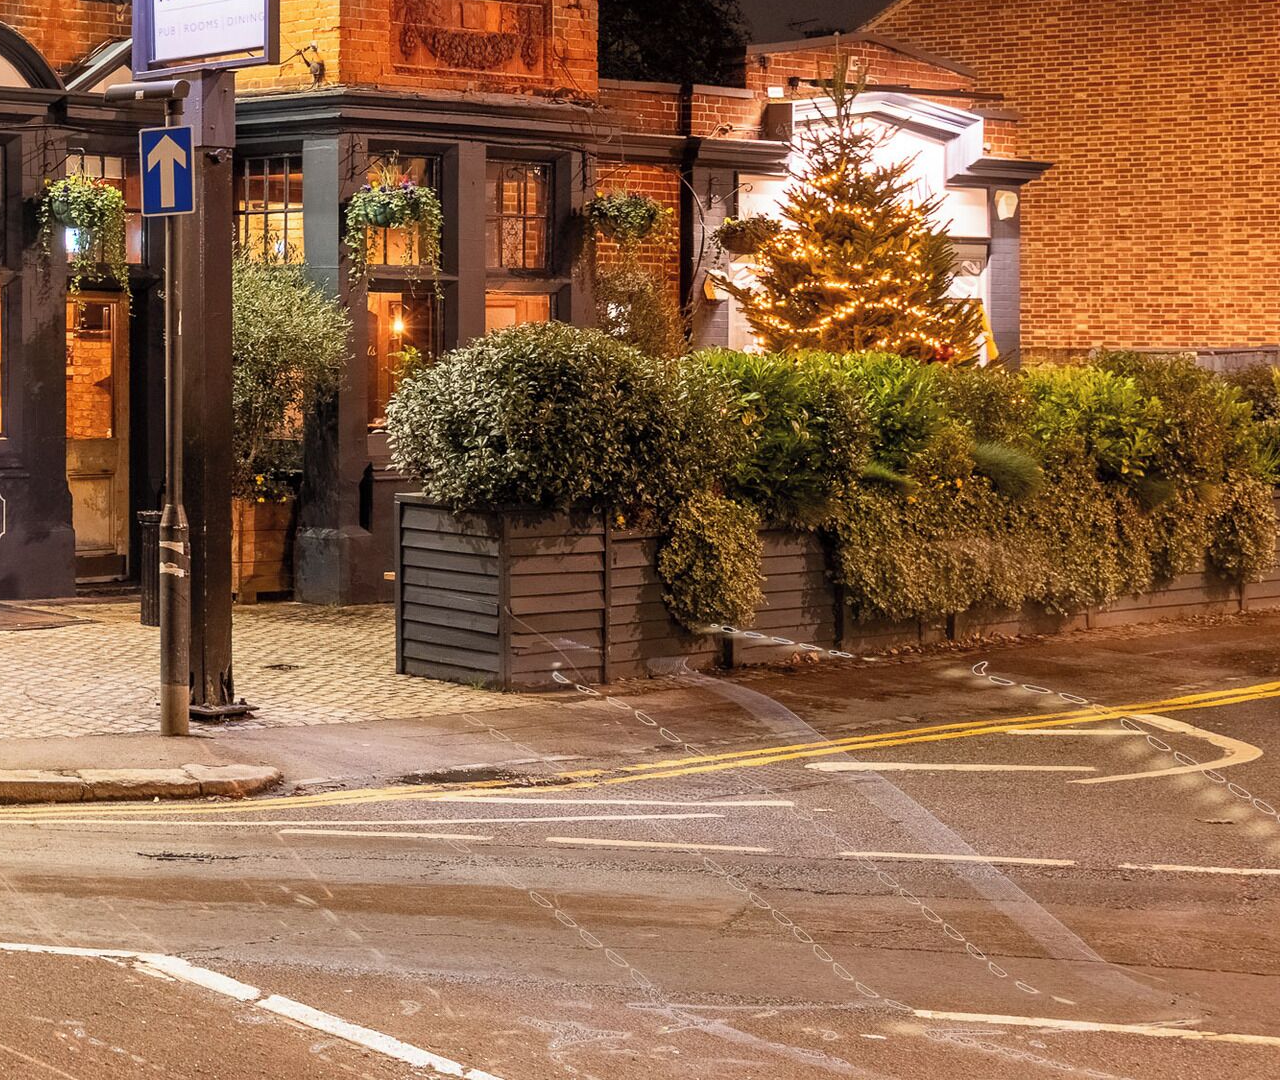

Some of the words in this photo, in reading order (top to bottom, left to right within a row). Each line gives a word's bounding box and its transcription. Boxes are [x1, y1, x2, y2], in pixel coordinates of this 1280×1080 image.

[159, 25, 176, 38] PUB
[183, 18, 219, 33] ROOMS
[227, 11, 265, 26] DINING
